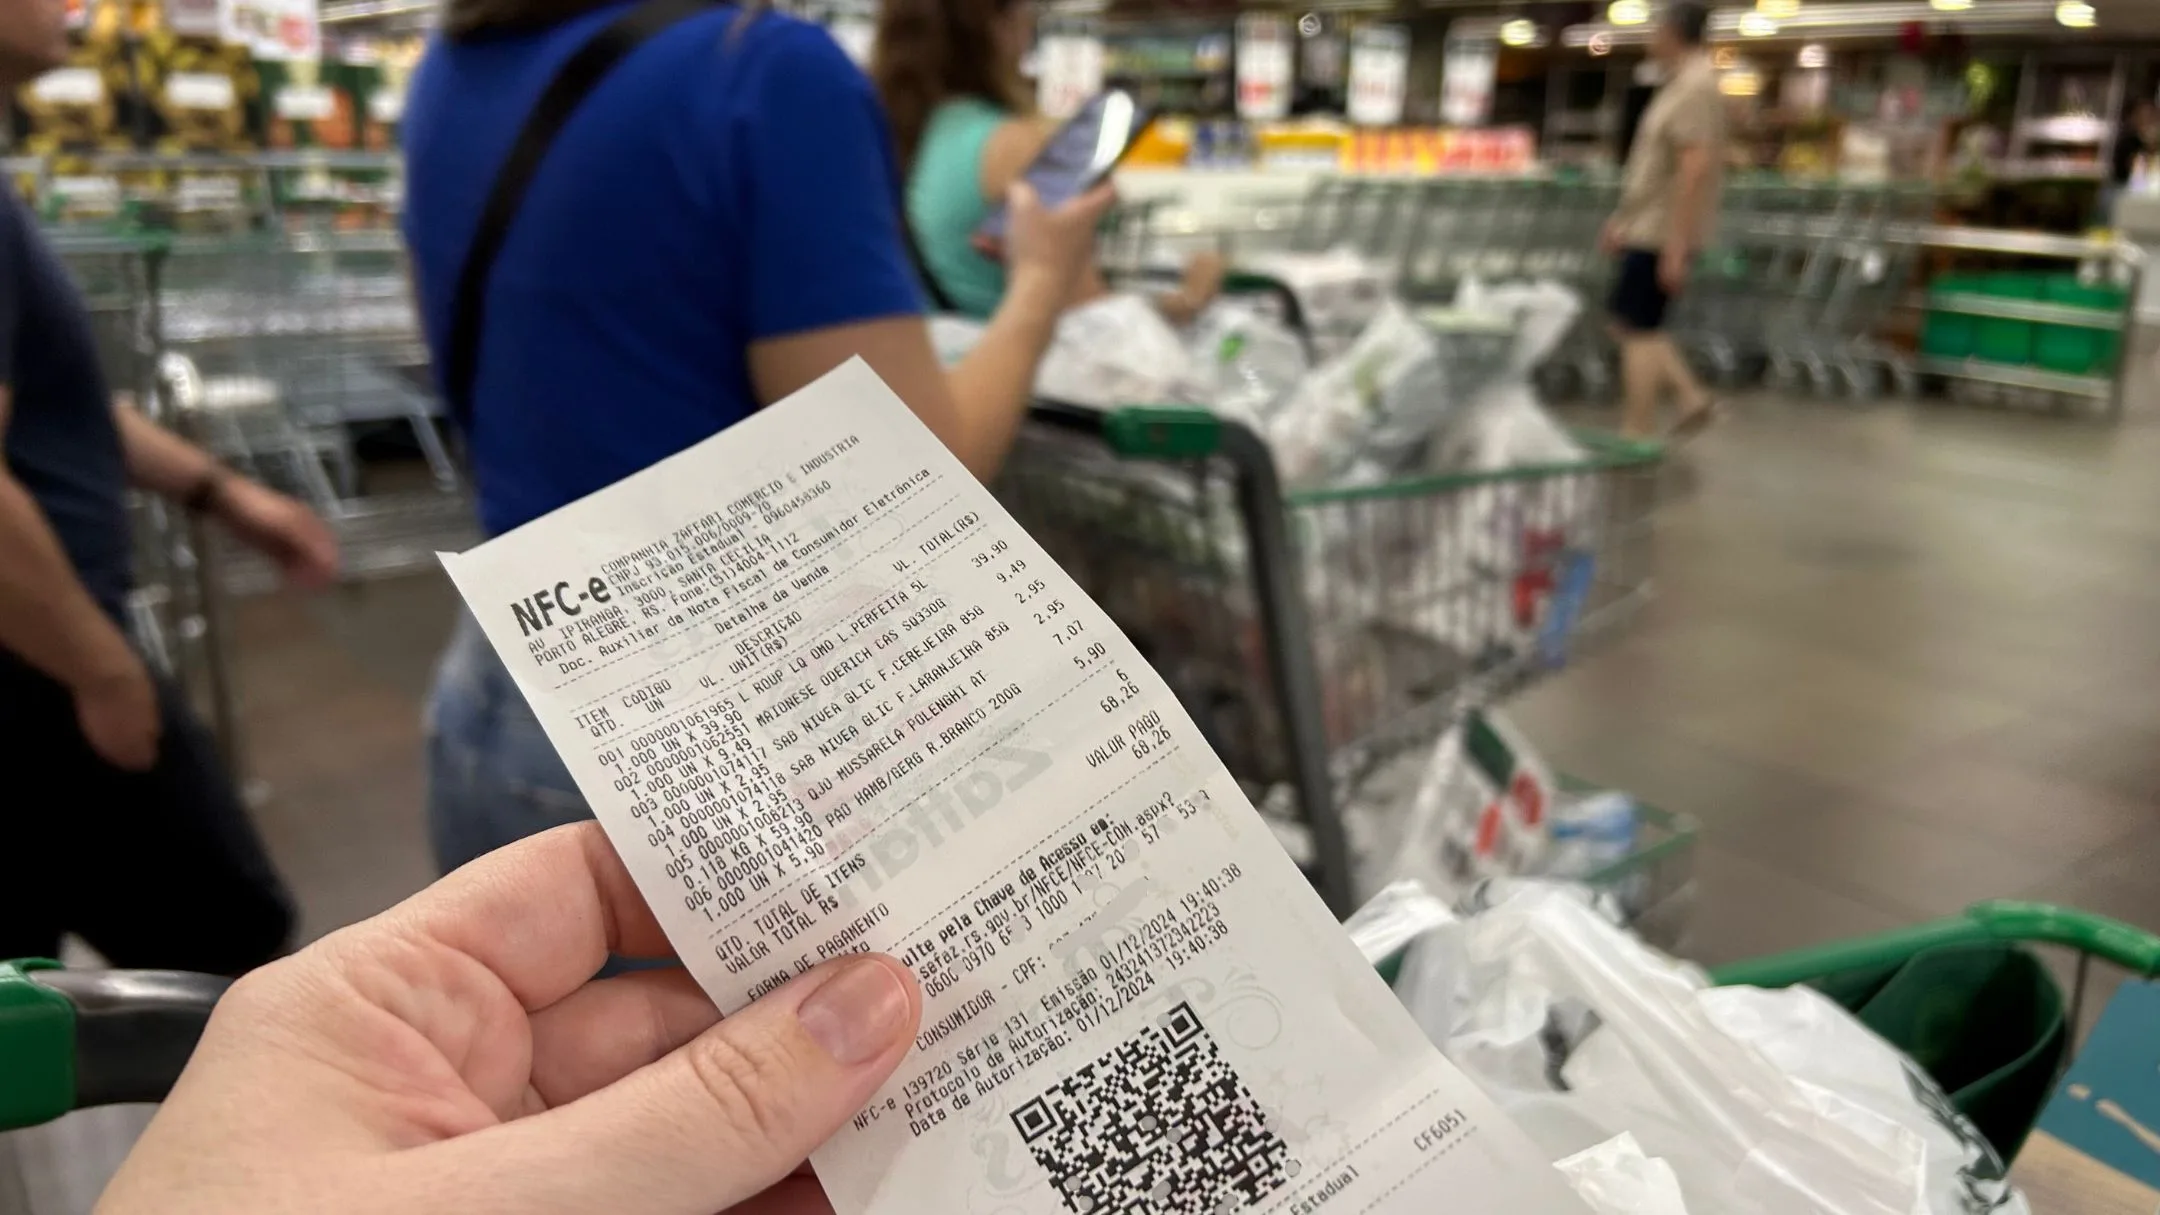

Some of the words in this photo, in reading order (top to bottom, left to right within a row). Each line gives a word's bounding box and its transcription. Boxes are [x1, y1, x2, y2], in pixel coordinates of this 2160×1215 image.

[600, 538, 669, 575] COMPANHIA
[672, 510, 723, 543] ZAFFARI
[726, 478, 784, 515] COMERCIO
[799, 434, 860, 475] INDUSTRIA
[607, 564, 641, 586] CNPJ
[644, 500, 772, 570] 93.015.006/0009-70
[508, 570, 613, 638] NFC-e
[527, 637, 546, 654] AV
[677, 561, 717, 588] SANTA
[558, 654, 593, 675] Doc.
[597, 622, 660, 657] Auxiliar
[665, 612, 684, 627] da
[686, 595, 720, 618] Nota
[721, 567, 768, 599] Fiscal
[771, 556, 789, 572] de
[791, 512, 859, 560] Consumidor
[862, 467, 930, 516] Eletrônica
[615, 558, 685, 597] Inscrição
[686, 527, 745, 565] Estadual
[713, 599, 769, 635] Detalhe
[771, 587, 789, 604] da
[790, 563, 830, 591] Venda
[534, 639, 577, 666] PORTO
[574, 705, 610, 729] ITEM
[733, 609, 803, 656] DESCRIÇÃO
[892, 555, 916, 574] VL.
[918, 510, 980, 556] TOTAL(R$)
[589, 716, 624, 738] QTD.
[644, 696, 665, 714] UN
[698, 671, 724, 690] VL.
[728, 634, 789, 675] UNIT(R$)
[597, 746, 625, 767] 001
[629, 696, 735, 752] 0000001061965
[737, 690, 750, 703] L
[751, 668, 785, 695] ROUP
[788, 655, 808, 674] LQ
[809, 638, 835, 661] OMO
[836, 589, 910, 643] L.PERFEITA
[909, 577, 928, 594] 5L
[613, 770, 642, 792] 002
[645, 721, 751, 777] 0000001062551
[755, 682, 818, 728] MAIONESE
[819, 646, 873, 688] ODERICH
[873, 628, 899, 651] CAS
[900, 596, 947, 633] SQ330G
[629, 797, 659, 819] 003
[662, 746, 768, 803] 0000001074117
[772, 728, 799, 752] SAB
[800, 701, 843, 734] NIVEA
[843, 677, 876, 705] GLIC
[877, 622, 958, 682] F.CEREJEIRA
[959, 603, 985, 626] 85G
[614, 747, 657, 775] 1.000
[660, 736, 682, 753] UN
[684, 729, 698, 743] X
[630, 772, 674, 802] 1.000
[677, 760, 699, 779] UN
[701, 754, 715, 768] X
[646, 823, 675, 848] 004
[679, 771, 787, 829] 0000001074118
[789, 752, 816, 776] SAB
[818, 723, 860, 758] NIVEA
[861, 699, 894, 728] GLIC
[895, 638, 984, 704] F.LARANJEIRA
[984, 619, 1010, 643] 85G
[664, 852, 694, 879] 005
[697, 797, 805, 860] 0000001008213
[806, 777, 834, 802] QJO
[835, 727, 906, 781] MUSSARELA
[906, 683, 968, 732] POLENGHI
[969, 669, 987, 688] AT
[646, 798, 691, 828] 1.000
[694, 786, 716, 805] UN
[718, 779, 732, 794] X
[664, 824, 709, 858] 1.000
[711, 812, 733, 832] UN
[735, 805, 750, 820] X
[684, 884, 713, 912] 006
[715, 822, 823, 892] 0000001041420
[824, 801, 852, 828] PAO
[853, 750, 924, 807] HAMB/GERG
[925, 706, 987, 756] R.BRANCO
[987, 681, 1022, 711] 200G
[714, 932, 750, 962] QTD.
[753, 898, 799, 936] TOTAL
[799, 881, 822, 906] DE
[824, 852, 867, 889] ITENS
[1115, 666, 1129, 683] 6
[729, 840, 752, 862] KG
[754, 832, 767, 848] X
[702, 885, 746, 923] 1.000
[748, 870, 771, 893] UN
[772, 860, 786, 878] X
[746, 968, 792, 1004] FORMA
[793, 952, 816, 975] DE
[815, 901, 890, 960] PAGAMENTO
[1085, 733, 1127, 768] VALOR
[1127, 708, 1161, 740] PAGO
[937, 911, 973, 945] pela
[972, 881, 1016, 917] Chave
[1017, 865, 1038, 887] de
[1038, 831, 1088, 872] Acesso
[1035, 888, 1069, 921] 1000
[725, 939, 771, 975] VALOR
[771, 909, 817, 946] TOTAL
[852, 1096, 897, 1131] NFC-e
[902, 1060, 953, 1100] 139720
[955, 1031, 1000, 1066] Série
[1004, 1010, 1030, 1036] 131
[1039, 966, 1098, 1013] Emissão
[1098, 907, 1178, 971] 01/12/2024
[1179, 861, 1242, 914] 19:40:38
[909, 1106, 947, 1137] Data
[950, 1091, 971, 1111] de
[974, 1028, 1072, 1096] Autorização:
[1075, 969, 1156, 1033] 01/12/2024
[1165, 918, 1229, 971] 19:40:38
[913, 988, 996, 1052] CONSUMIDOR
[1011, 954, 1046, 985] CPF:
[903, 1063, 981, 1119] Protocolo
[985, 1049, 1005, 1069] de
[1007, 985, 1103, 1055] Autorização:
[1289, 1164, 1360, 1215] Estadual
